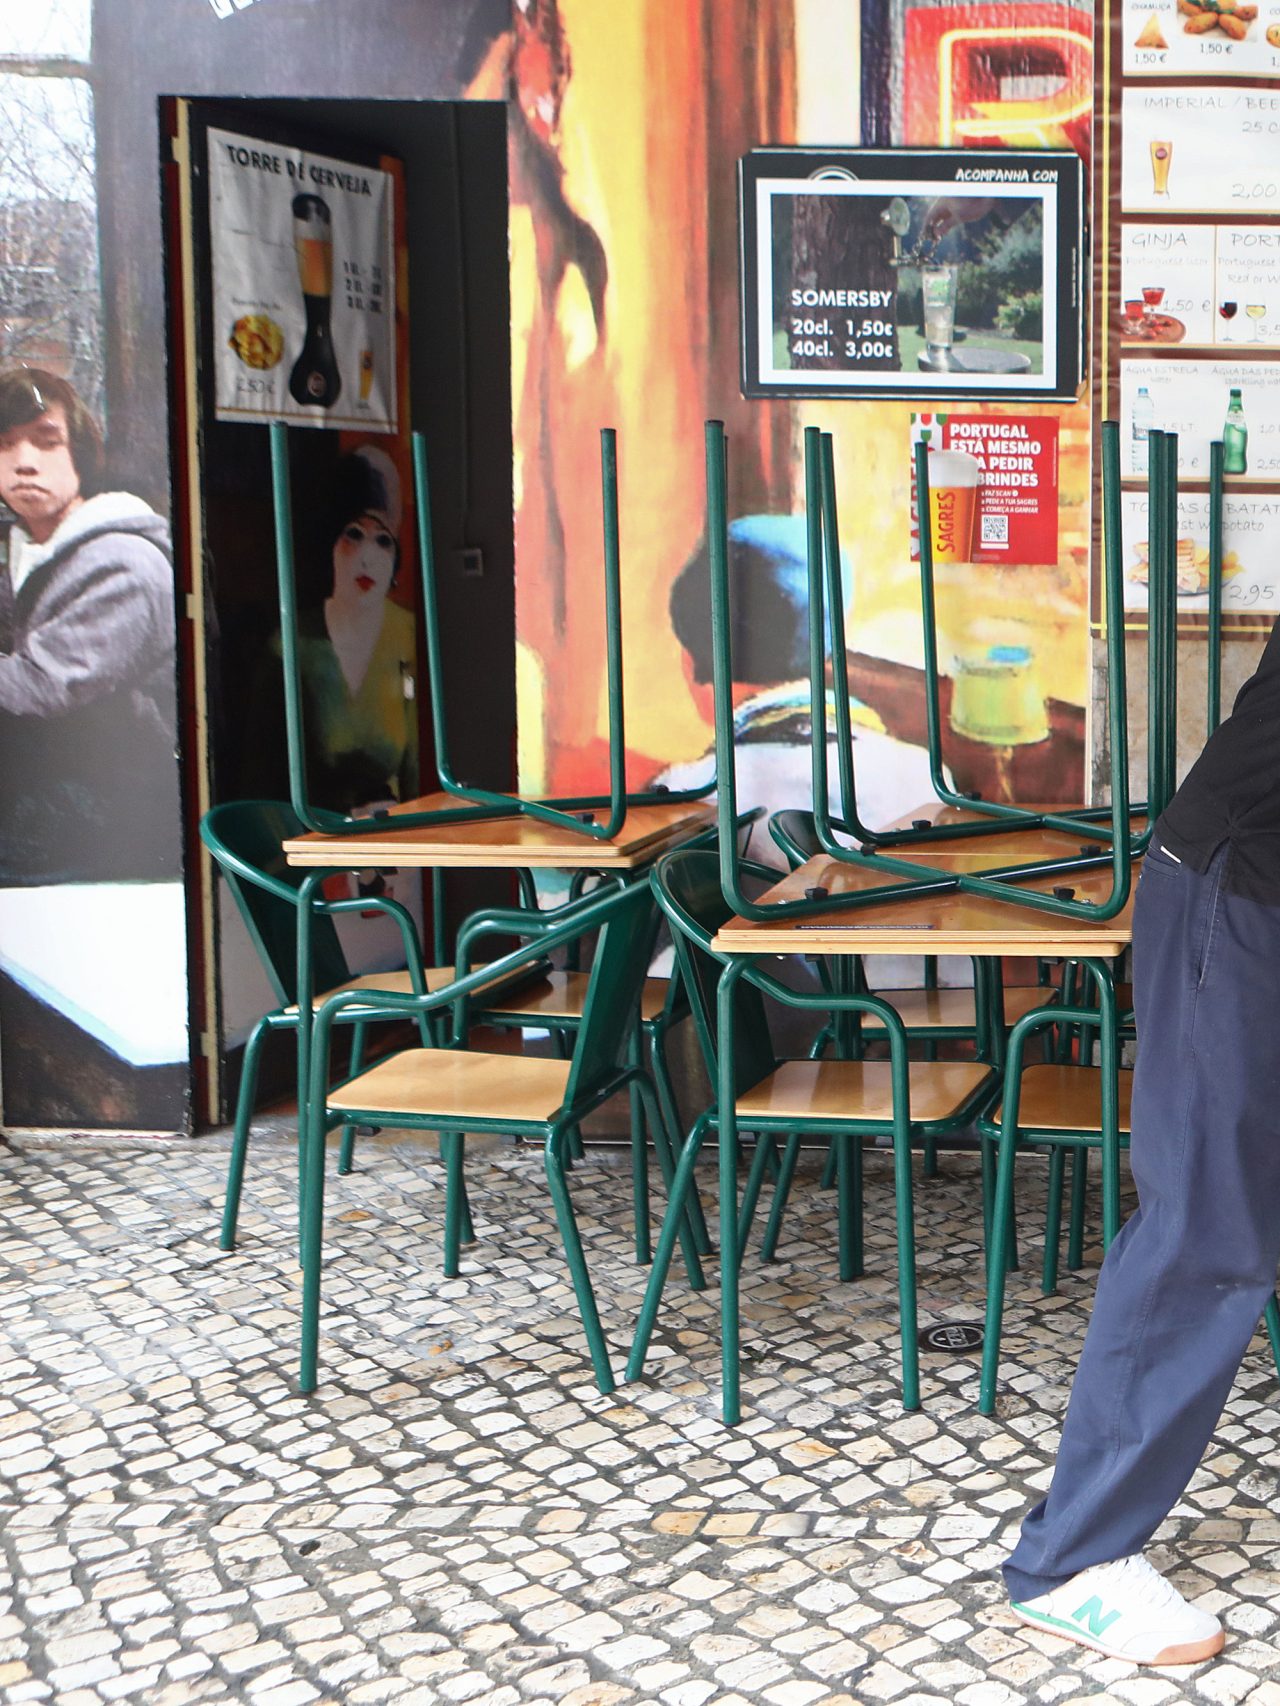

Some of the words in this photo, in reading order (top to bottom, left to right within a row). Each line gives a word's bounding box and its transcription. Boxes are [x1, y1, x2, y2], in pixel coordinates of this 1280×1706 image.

[1201, 43, 1222, 54] 1,50
[1226, 44, 1233, 54] €
[1135, 54, 1156, 64] 1,50
[1160, 53, 1167, 63] €
[1144, 97, 1224, 108] IMPERIAL
[1242, 121, 1263, 133] 25
[227, 144, 281, 175] TORRE
[311, 164, 372, 197] CERVEJA
[955, 168, 1029, 182] ACOMPANHA
[1033, 169, 1058, 182] COM
[1231, 183, 1277, 199] 2,00
[1132, 232, 1188, 251] GINJA
[1218, 257, 1276, 270] Portuguese
[1228, 274, 1249, 284] Red
[791, 288, 893, 308] SOMERSBY
[1164, 300, 1193, 312] 1,50
[1202, 300, 1211, 312] €
[792, 319, 833, 336] 20cl.
[792, 341, 834, 357] 40cl.
[950, 423, 1028, 438] PORTUGAL
[988, 441, 1041, 455] MESMO
[990, 457, 1034, 470] PEDIR
[937, 492, 955, 552] SAGRES
[1230, 585, 1275, 606] 2,95
